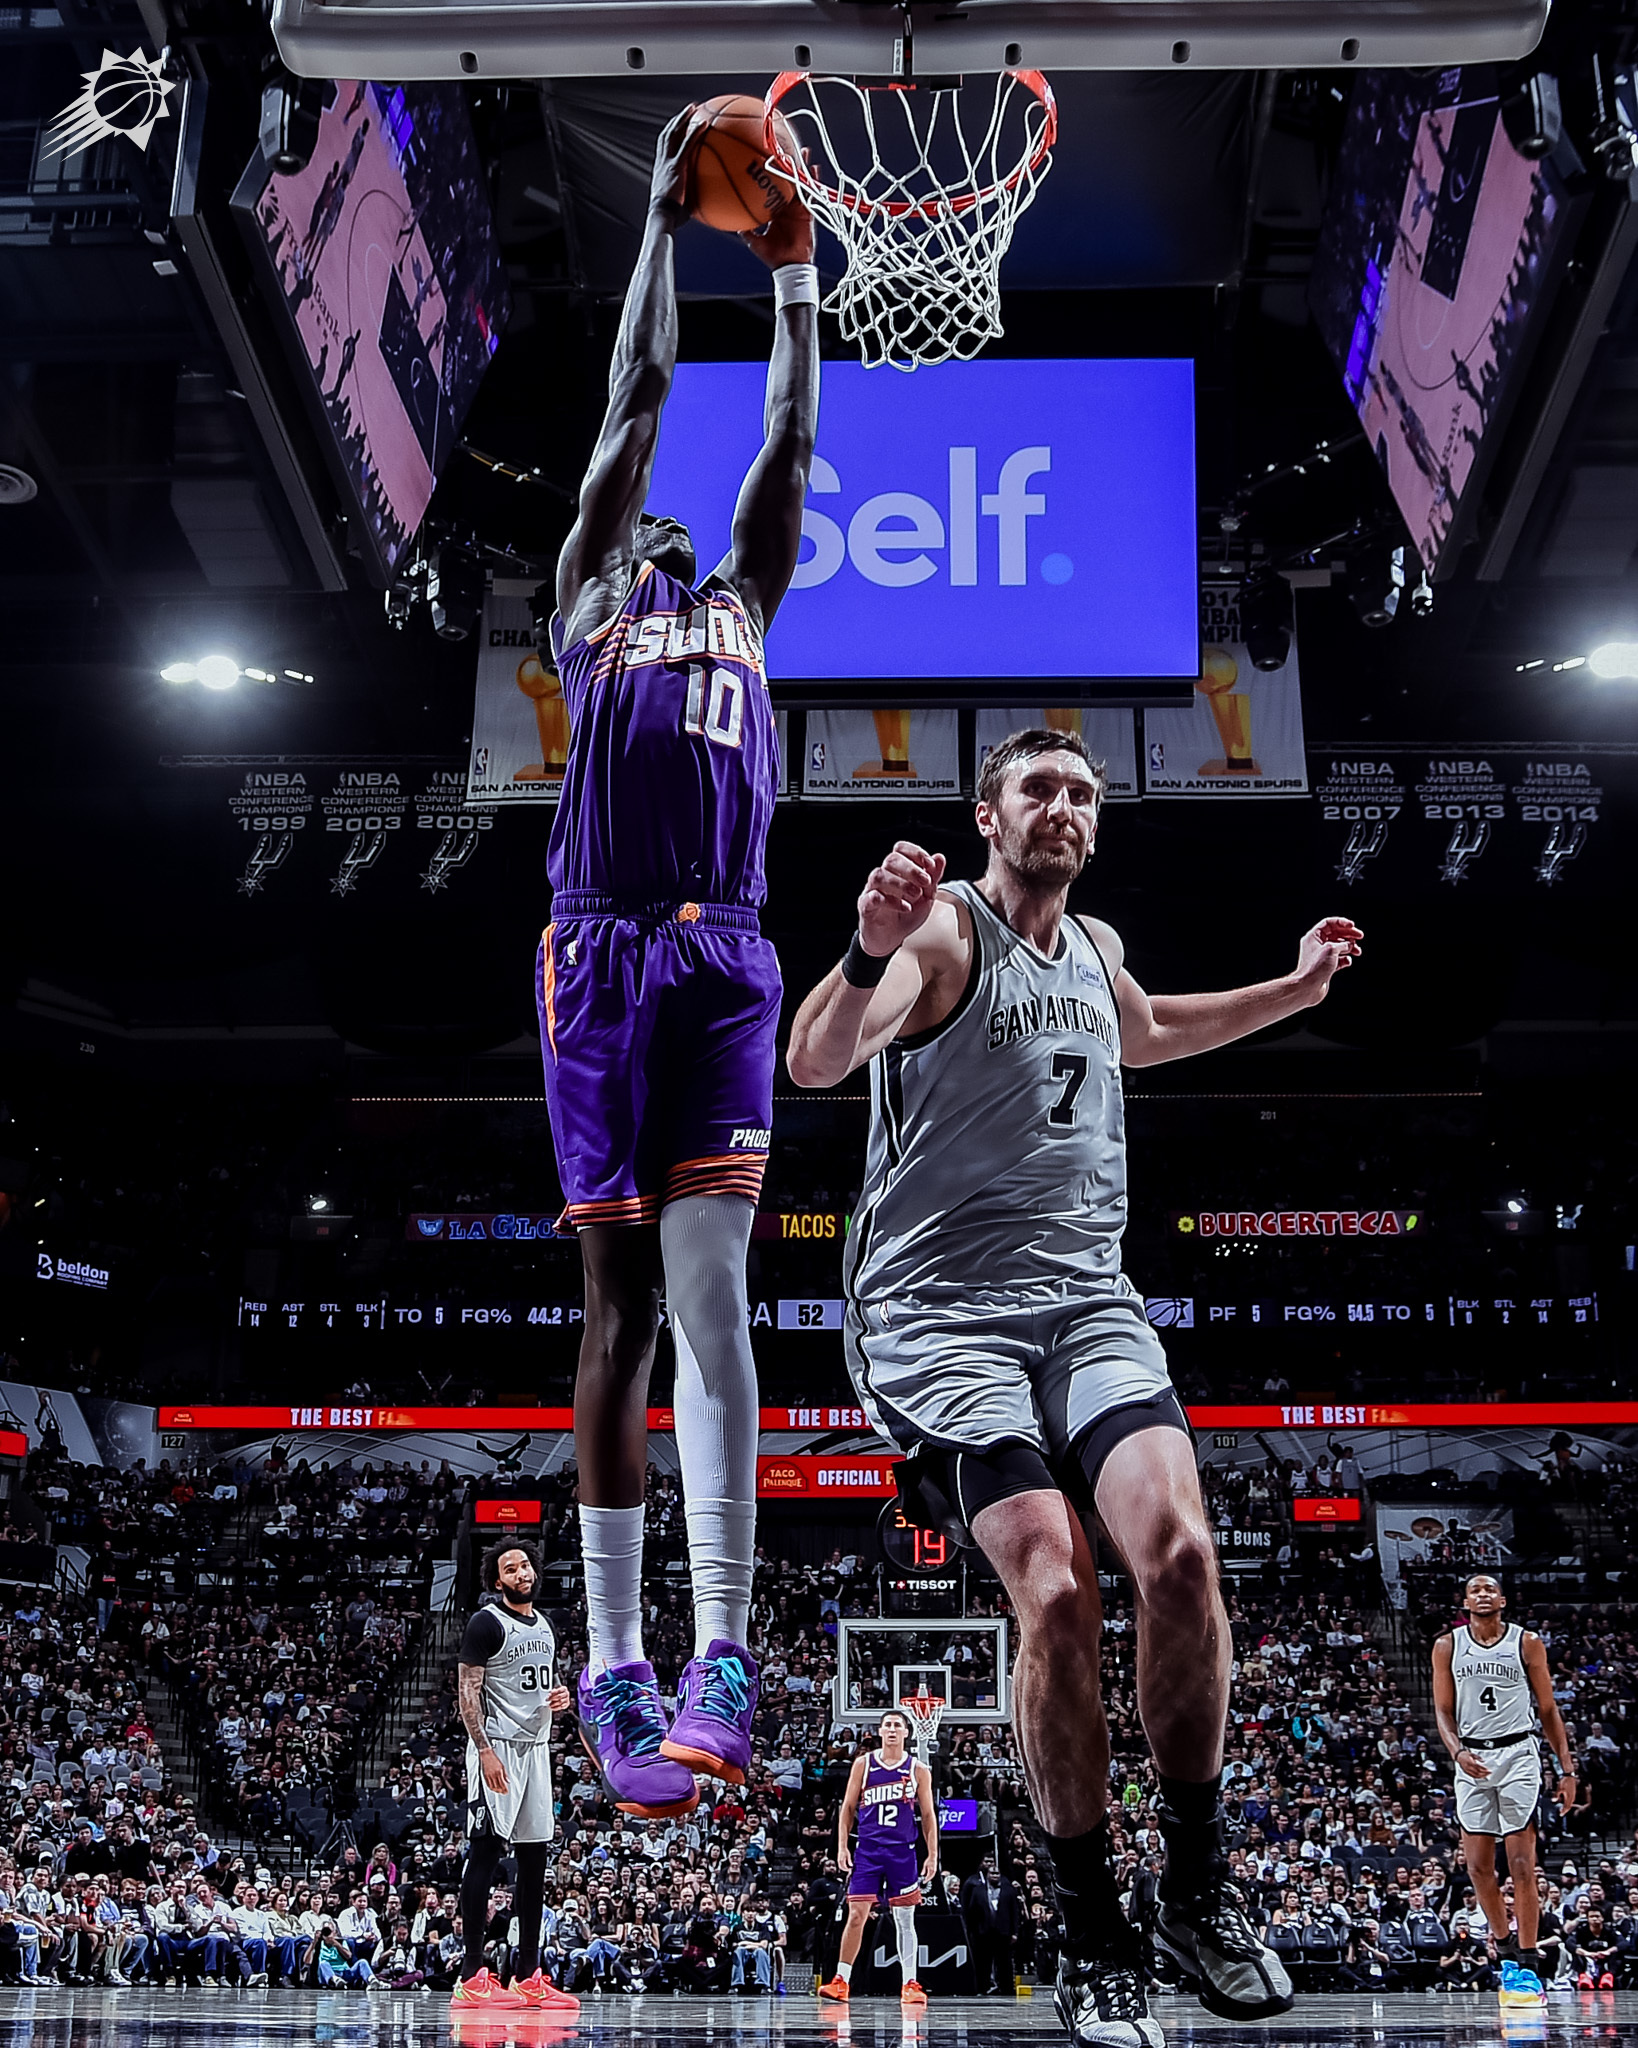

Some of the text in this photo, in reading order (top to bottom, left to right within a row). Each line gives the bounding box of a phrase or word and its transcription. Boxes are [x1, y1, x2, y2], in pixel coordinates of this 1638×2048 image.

[685, 663, 743, 748] 10
[1341, 762, 1394, 775] NBA
[1439, 761, 1493, 774] NBA
[1538, 763, 1590, 776] NBA
[255, 773, 307, 786] NBA
[347, 773, 400, 786] NBA
[808, 779, 955, 788] SAN ANTONIO SPURS
[1151, 779, 1303, 788] SAN ANTONIO SPURS
[1425, 775, 1493, 783] WESTERN
[1522, 777, 1591, 786] WESTERN
[240, 787, 305, 795] WESTERN
[332, 787, 399, 795] WESTERN
[471, 785, 499, 793] SAN
[1415, 784, 1506, 793] CONFERENCE
[228, 795, 315, 805] CONFERENCE
[321, 796, 410, 805] CONFERENCE
[1319, 795, 1404, 803] CHAMPIONS
[1419, 793, 1505, 802] CHAMPIONS
[232, 804, 312, 814] CHAMPIONS
[323, 805, 405, 814] CHAMPIONS
[1323, 806, 1401, 820] 2007
[1424, 805, 1505, 819] 2013
[1522, 806, 1599, 822] 2014
[238, 816, 306, 831] 1999
[325, 816, 402, 831] 2003
[417, 815, 494, 830] 2005
[988, 998, 1041, 1051] SAN
[79, 1042, 95, 1054] 230
[1048, 1050, 1089, 1129] 7
[780, 1215, 835, 1238] TACOS
[1200, 1211, 1400, 1236] BURGERTECA
[57, 1258, 109, 1281] beldon
[244, 1302, 378, 1312] REB AST STL BLK
[1457, 1300, 1479, 1309] BLK
[1494, 1300, 1516, 1309] STL
[1530, 1299, 1553, 1308] AST
[394, 1309, 422, 1324] TO
[435, 1307, 443, 1325] 5
[461, 1309, 512, 1324] FG%
[527, 1307, 562, 1325] 44.2
[797, 1303, 825, 1327] 52
[1209, 1304, 1434, 1322] PF 5 FG% 54.5 TO 5
[1465, 1311, 1472, 1324] 0
[1502, 1311, 1509, 1324] 2
[251, 1314, 370, 1328] 14 12 4 3
[290, 1408, 323, 1426] THE
[329, 1408, 373, 1426] BEST
[787, 1409, 821, 1426] THE
[1280, 1406, 1315, 1425] THE
[1321, 1406, 1366, 1424] BEST
[163, 1434, 184, 1448] 127
[1215, 1436, 1236, 1448] 101
[770, 1469, 796, 1478] TACO
[817, 1470, 881, 1485] OFFICIAL
[763, 1479, 803, 1488] PALENQUE
[1233, 1530, 1271, 1547] BUMS
[914, 1529, 945, 1564] 19
[907, 1580, 957, 1590] TISSOT
[507, 1643, 525, 1663] SAN
[521, 1664, 550, 1691] 30
[1456, 1662, 1519, 1682] SAN ANTONIO
[1480, 1686, 1497, 1711] 4
[864, 1782, 905, 1805] SUNS
[878, 1804, 899, 1827] 12
